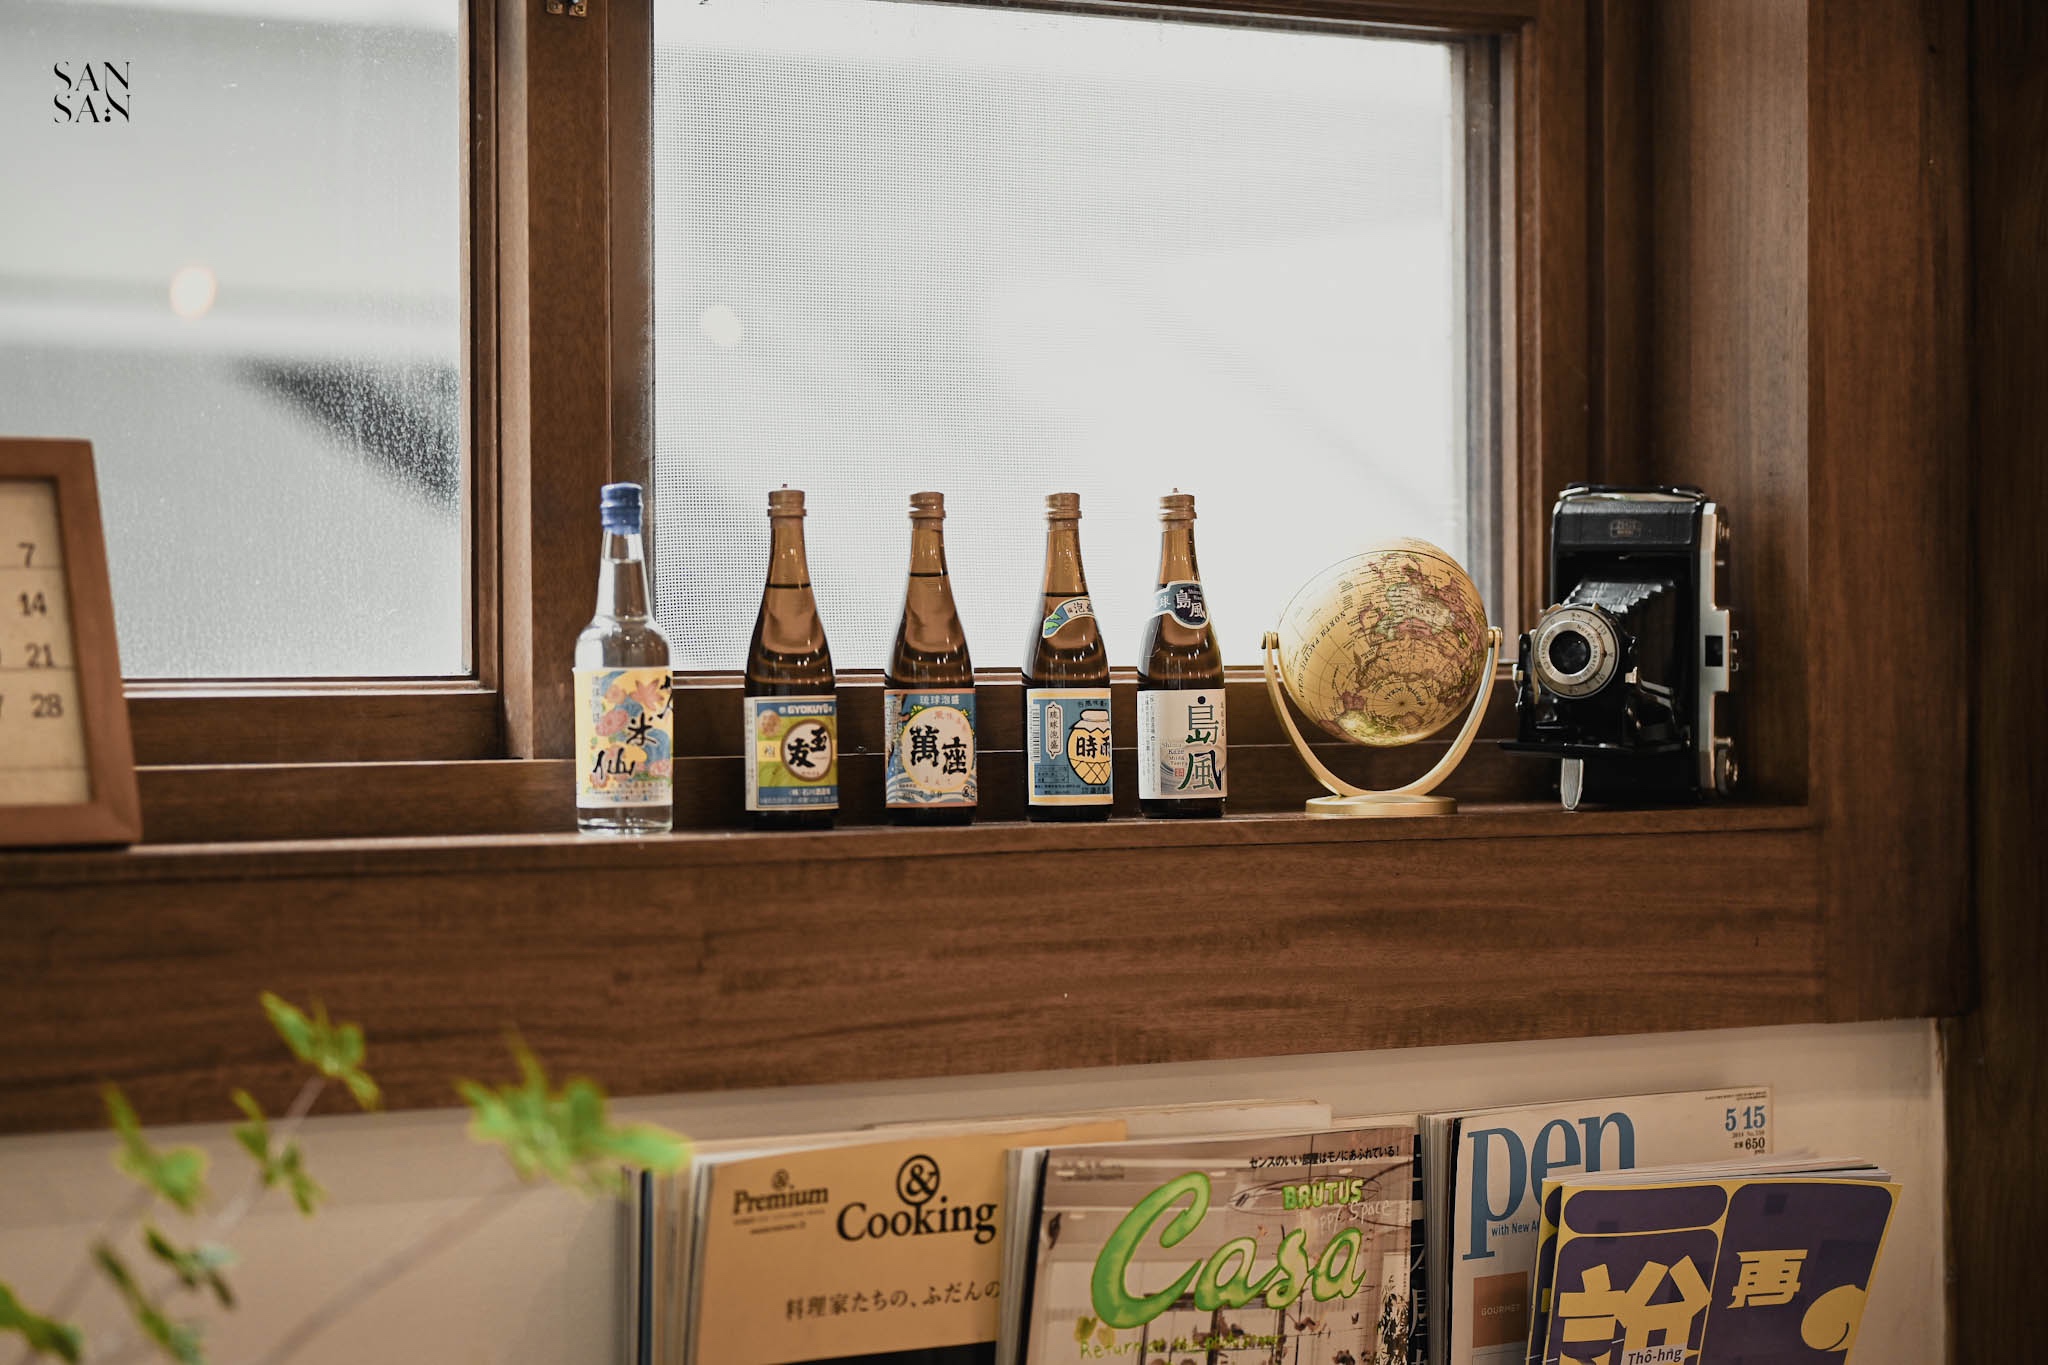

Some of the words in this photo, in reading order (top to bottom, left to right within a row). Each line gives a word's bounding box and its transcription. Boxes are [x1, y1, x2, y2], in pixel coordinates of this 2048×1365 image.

[18, 541, 36, 568] 7
[20, 591, 47, 616] 14
[1175, 589, 1207, 619] 島風
[25, 643, 54, 669] 21
[30, 693, 64, 718] 28
[908, 725, 967, 775] 萬座
[1177, 696, 1222, 791] 島風
[1725, 1108, 1737, 1131] 5
[1743, 1106, 1766, 1130] 15
[1745, 1136, 1765, 1150] 650
[1282, 1179, 1364, 1210] BRUTUS
[1463, 1112, 1635, 1260] pen
[734, 1188, 828, 1215] Premium
[837, 1196, 998, 1245] Cooking
[1491, 1225, 1509, 1237] with
[1512, 1222, 1529, 1233] New
[1091, 1171, 1366, 1329] Casa
[1727, 1249, 1808, 1309] 再
[1481, 1304, 1521, 1316] GOURMET
